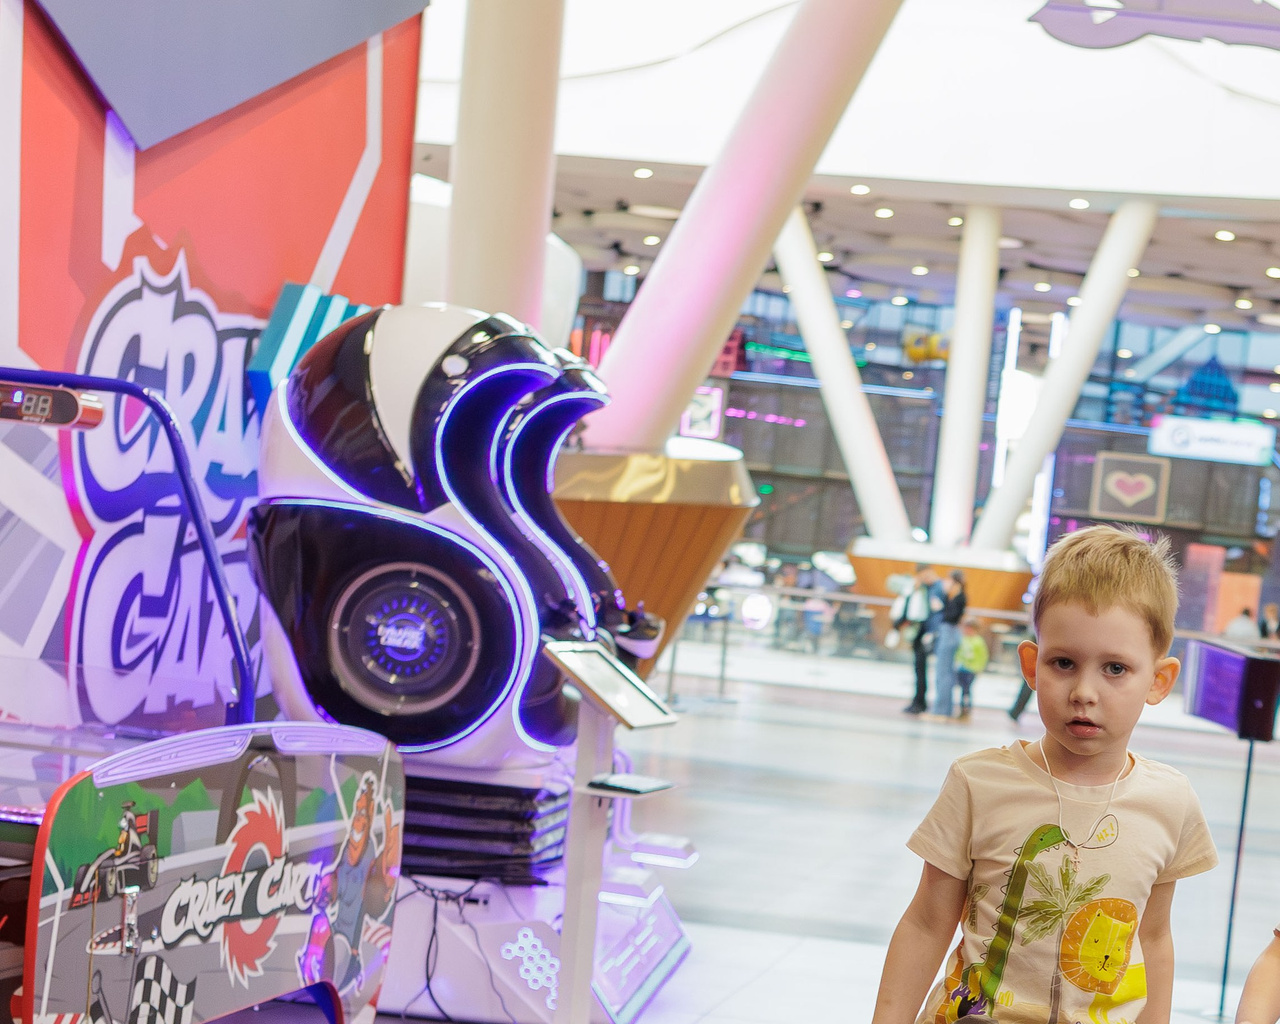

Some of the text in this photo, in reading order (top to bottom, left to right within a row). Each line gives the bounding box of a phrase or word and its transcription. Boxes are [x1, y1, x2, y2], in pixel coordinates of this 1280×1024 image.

[82, 514, 272, 726] CAR
[161, 857, 322, 944] CRAZY CART
